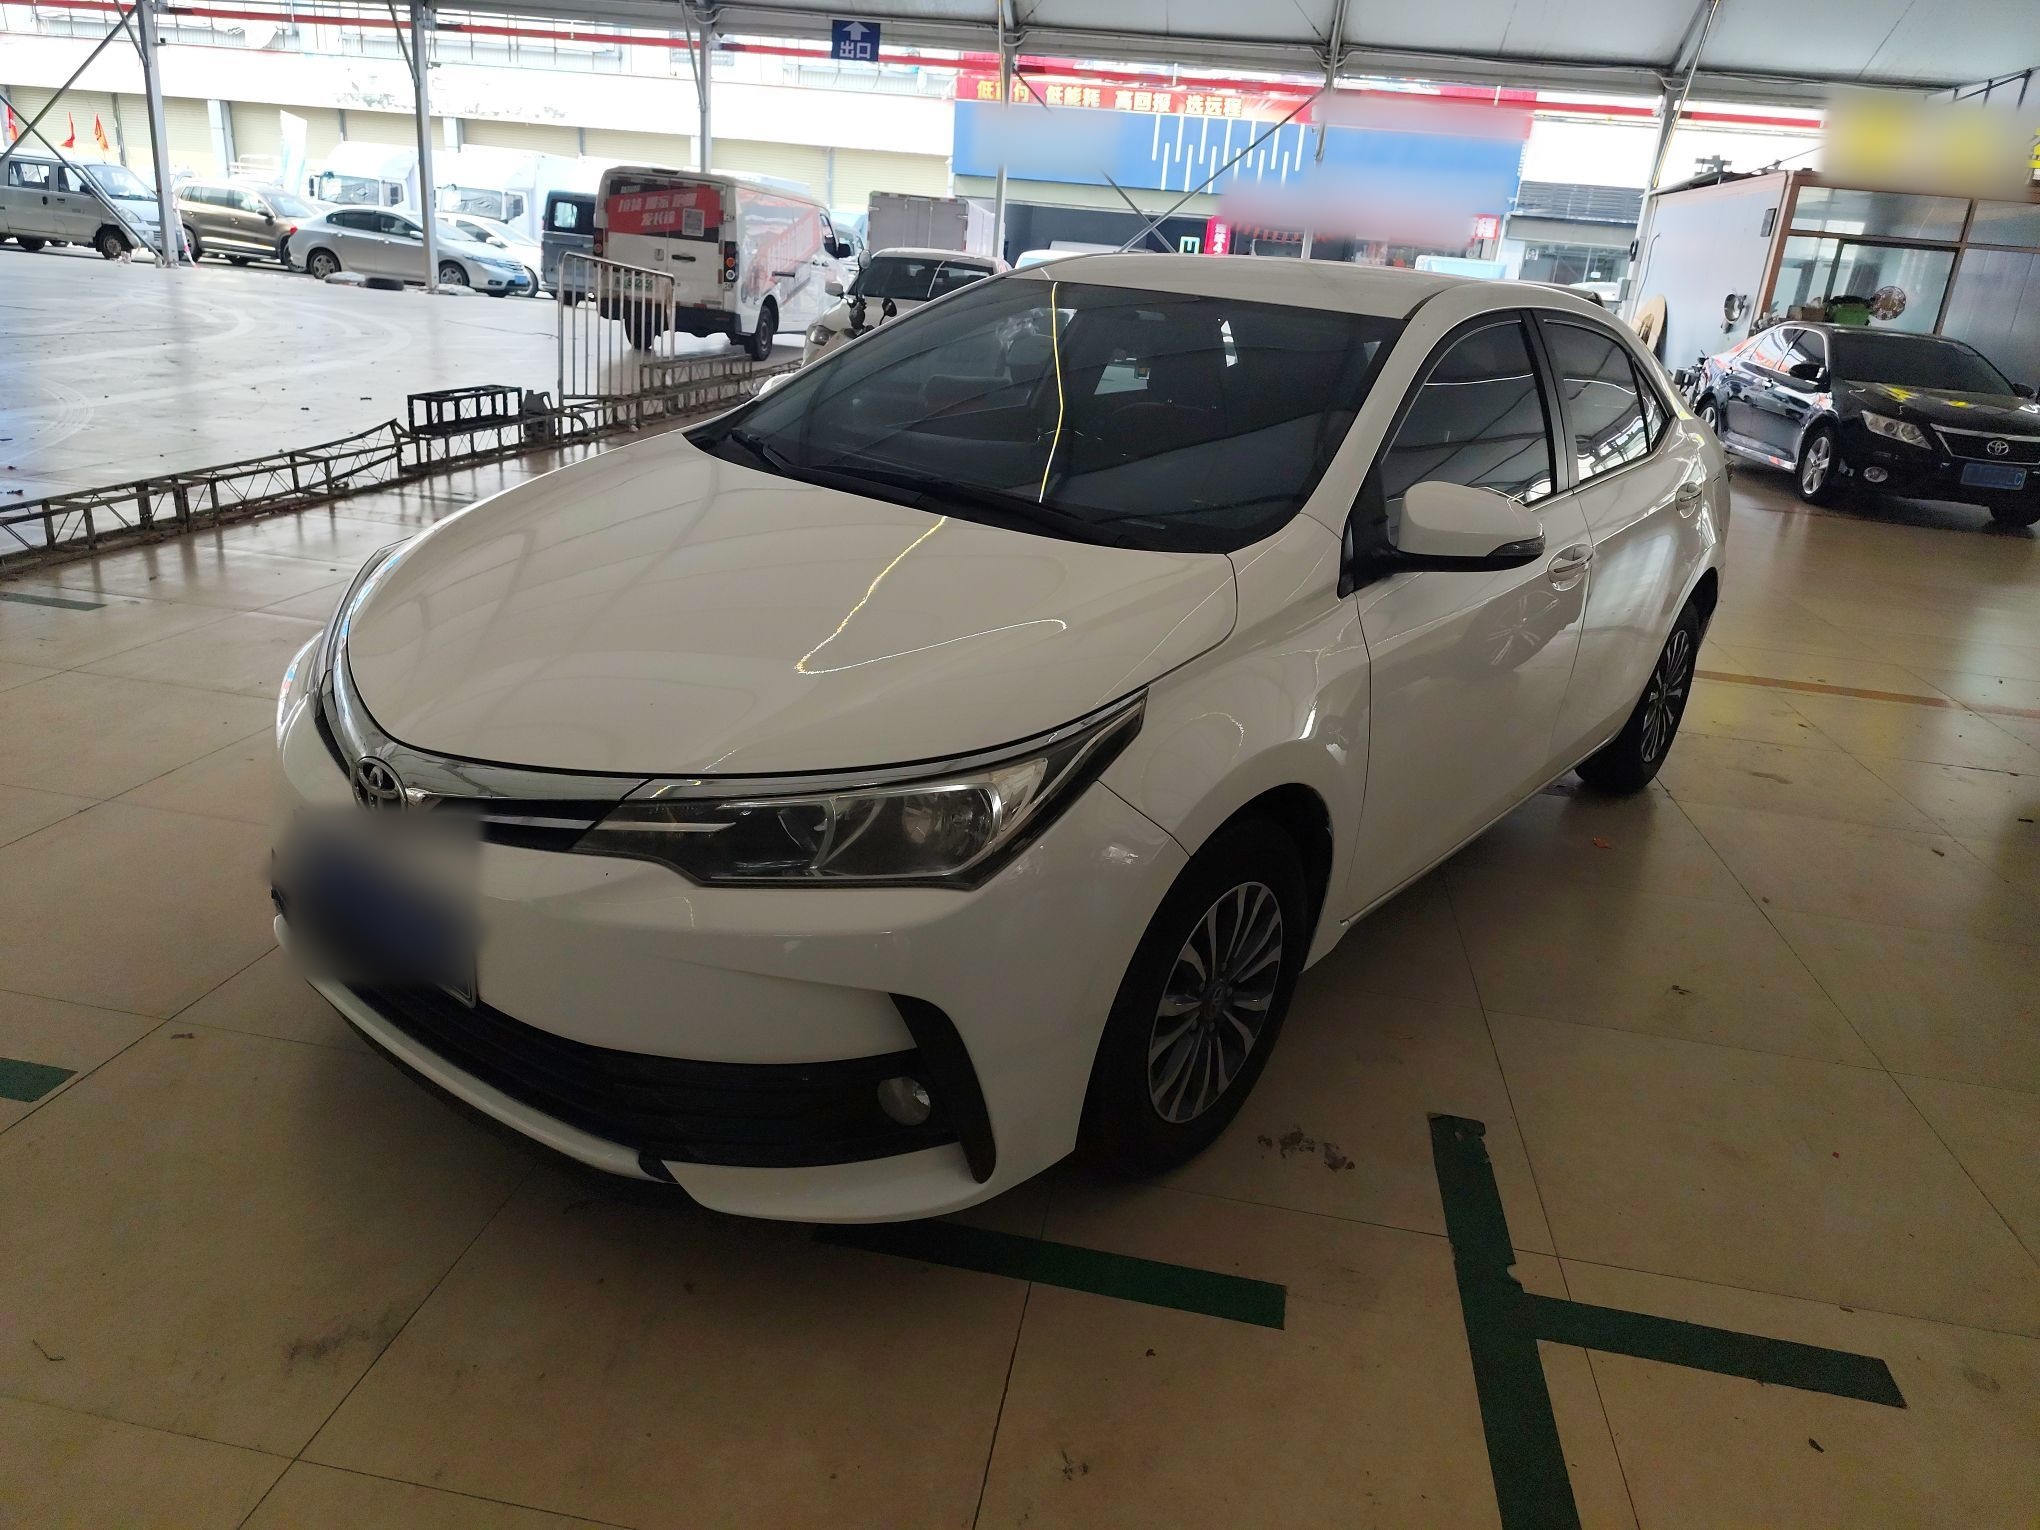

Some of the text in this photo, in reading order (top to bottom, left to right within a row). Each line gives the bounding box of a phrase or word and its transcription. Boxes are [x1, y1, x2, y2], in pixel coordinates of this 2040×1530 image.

[839, 40, 871, 59] 出口
[1045, 85, 1101, 108] 低能耗
[1114, 90, 1172, 113] 高回报
[1185, 94, 1243, 117] 选远程
